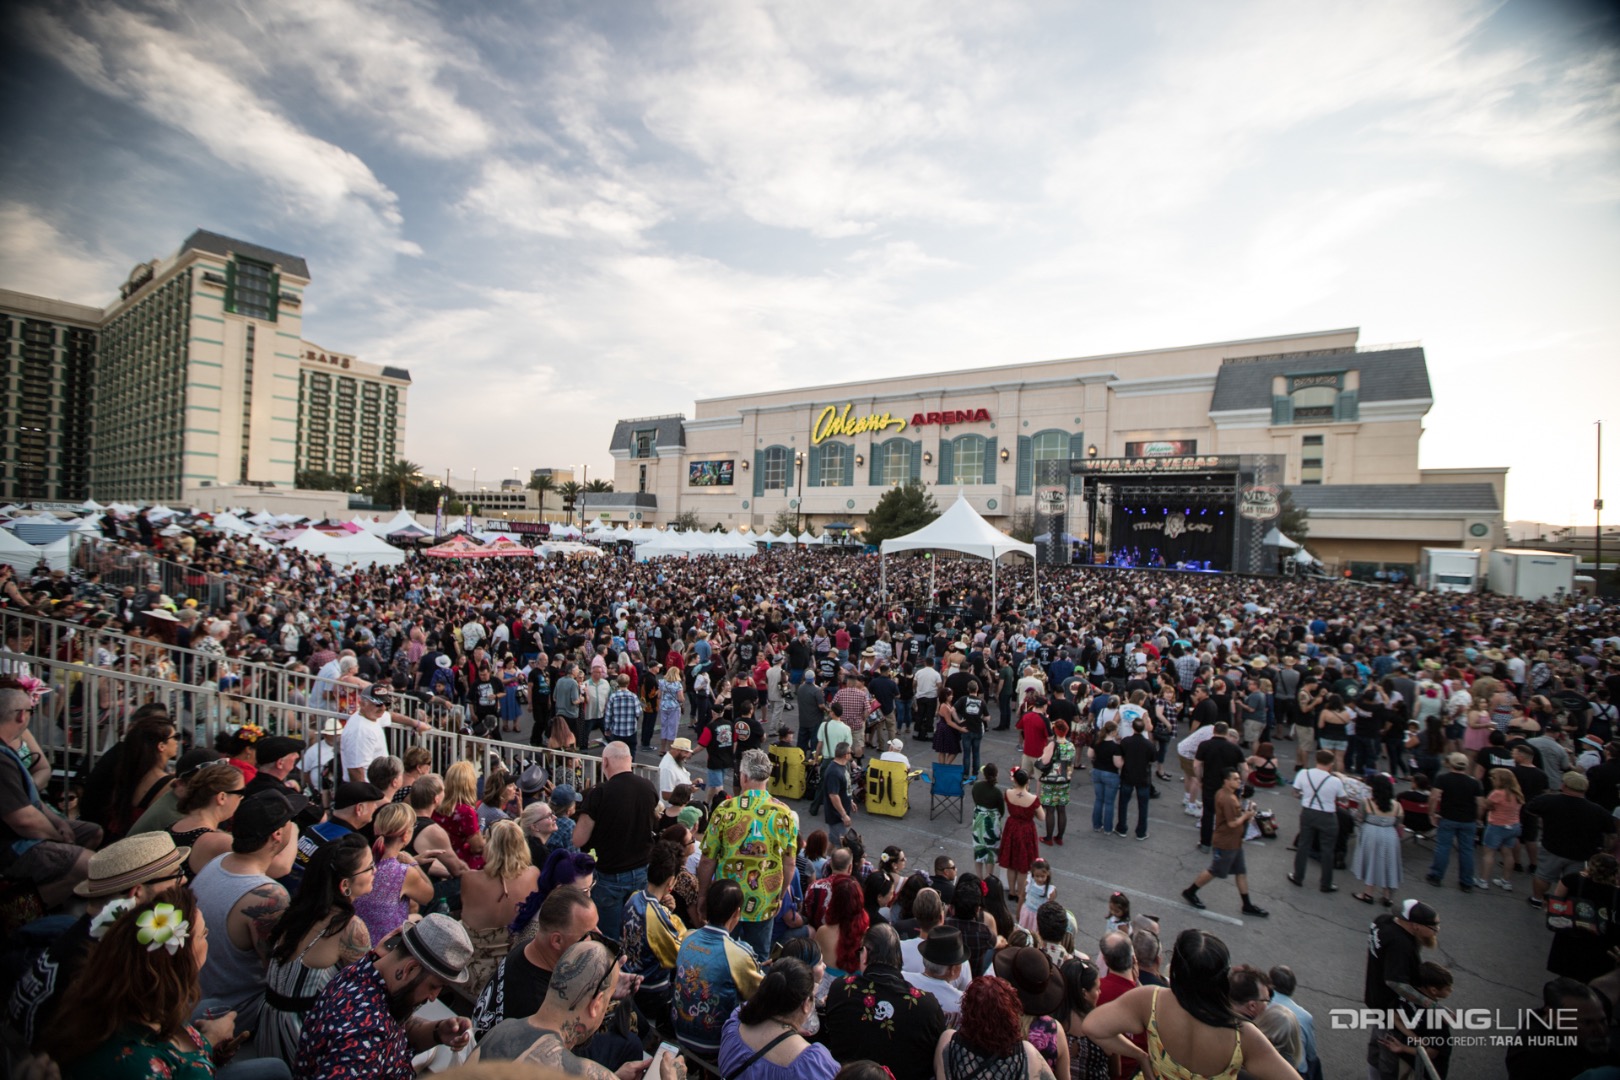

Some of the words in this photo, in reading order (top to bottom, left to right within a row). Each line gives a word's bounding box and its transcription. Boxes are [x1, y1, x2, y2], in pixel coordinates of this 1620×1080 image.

[811, 403, 907, 444] Orleans
[910, 408, 992, 427] ARENA
[1085, 459, 1121, 469] VIVA
[1125, 458, 1157, 468] LAS
[1162, 456, 1219, 467] VEGAS
